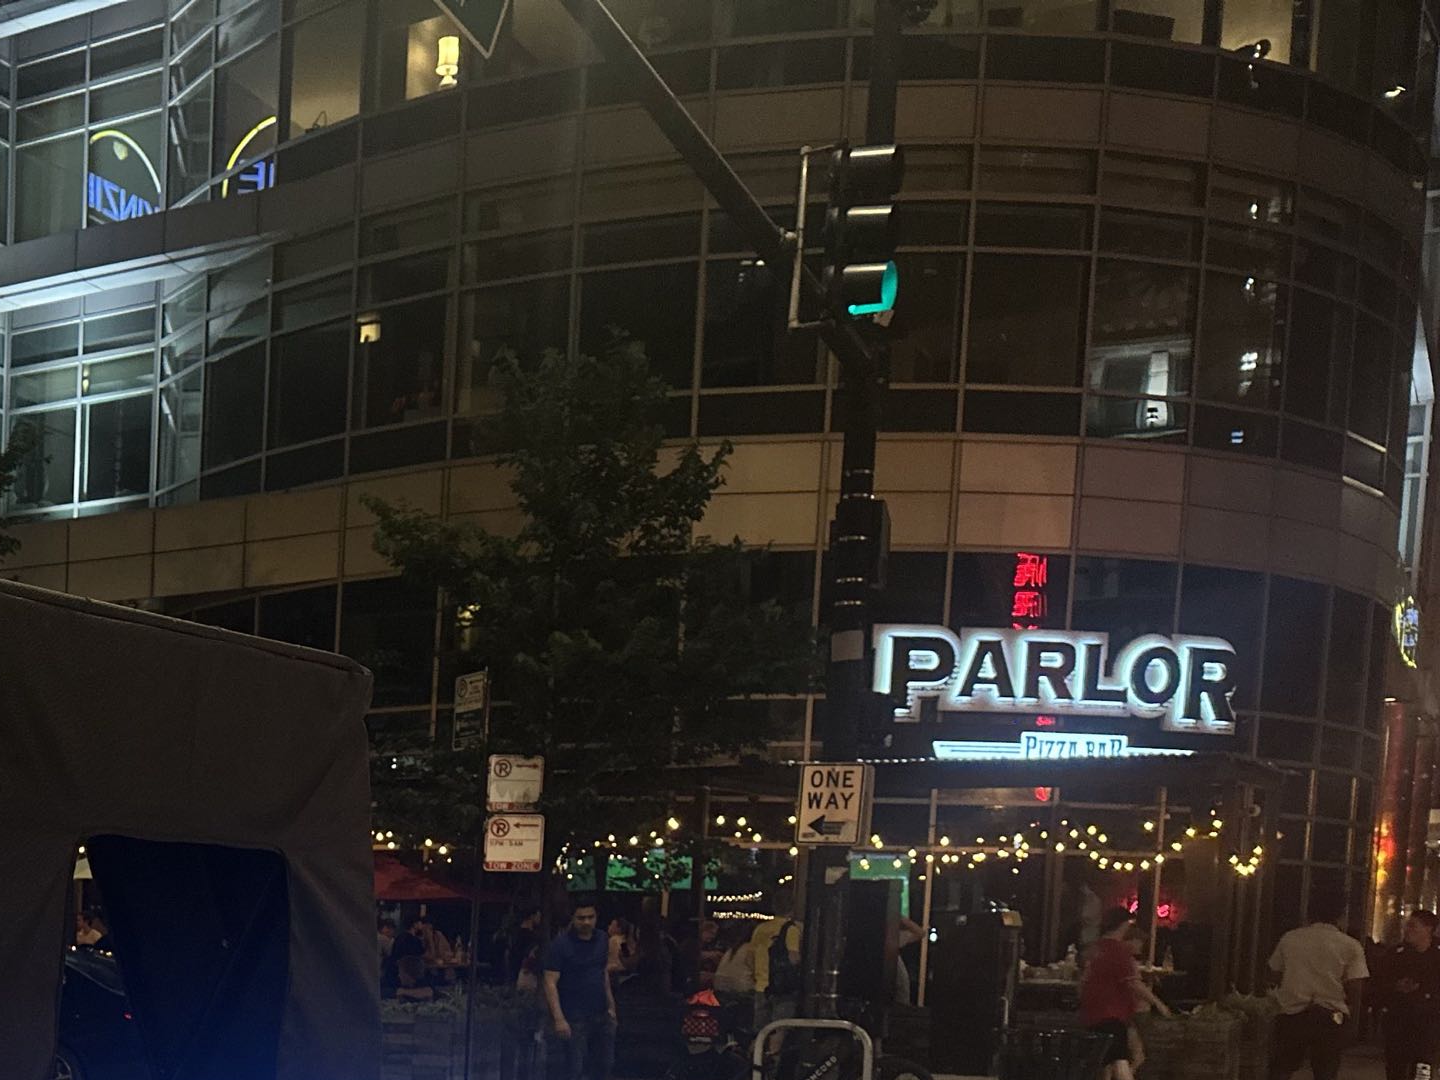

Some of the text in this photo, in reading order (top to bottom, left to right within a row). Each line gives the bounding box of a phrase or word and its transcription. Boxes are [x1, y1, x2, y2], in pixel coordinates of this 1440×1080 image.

[879, 630, 1238, 730] PARLOR
[811, 770, 855, 788] ONE
[808, 792, 855, 810] WAY
[488, 861, 507, 870] TOW
